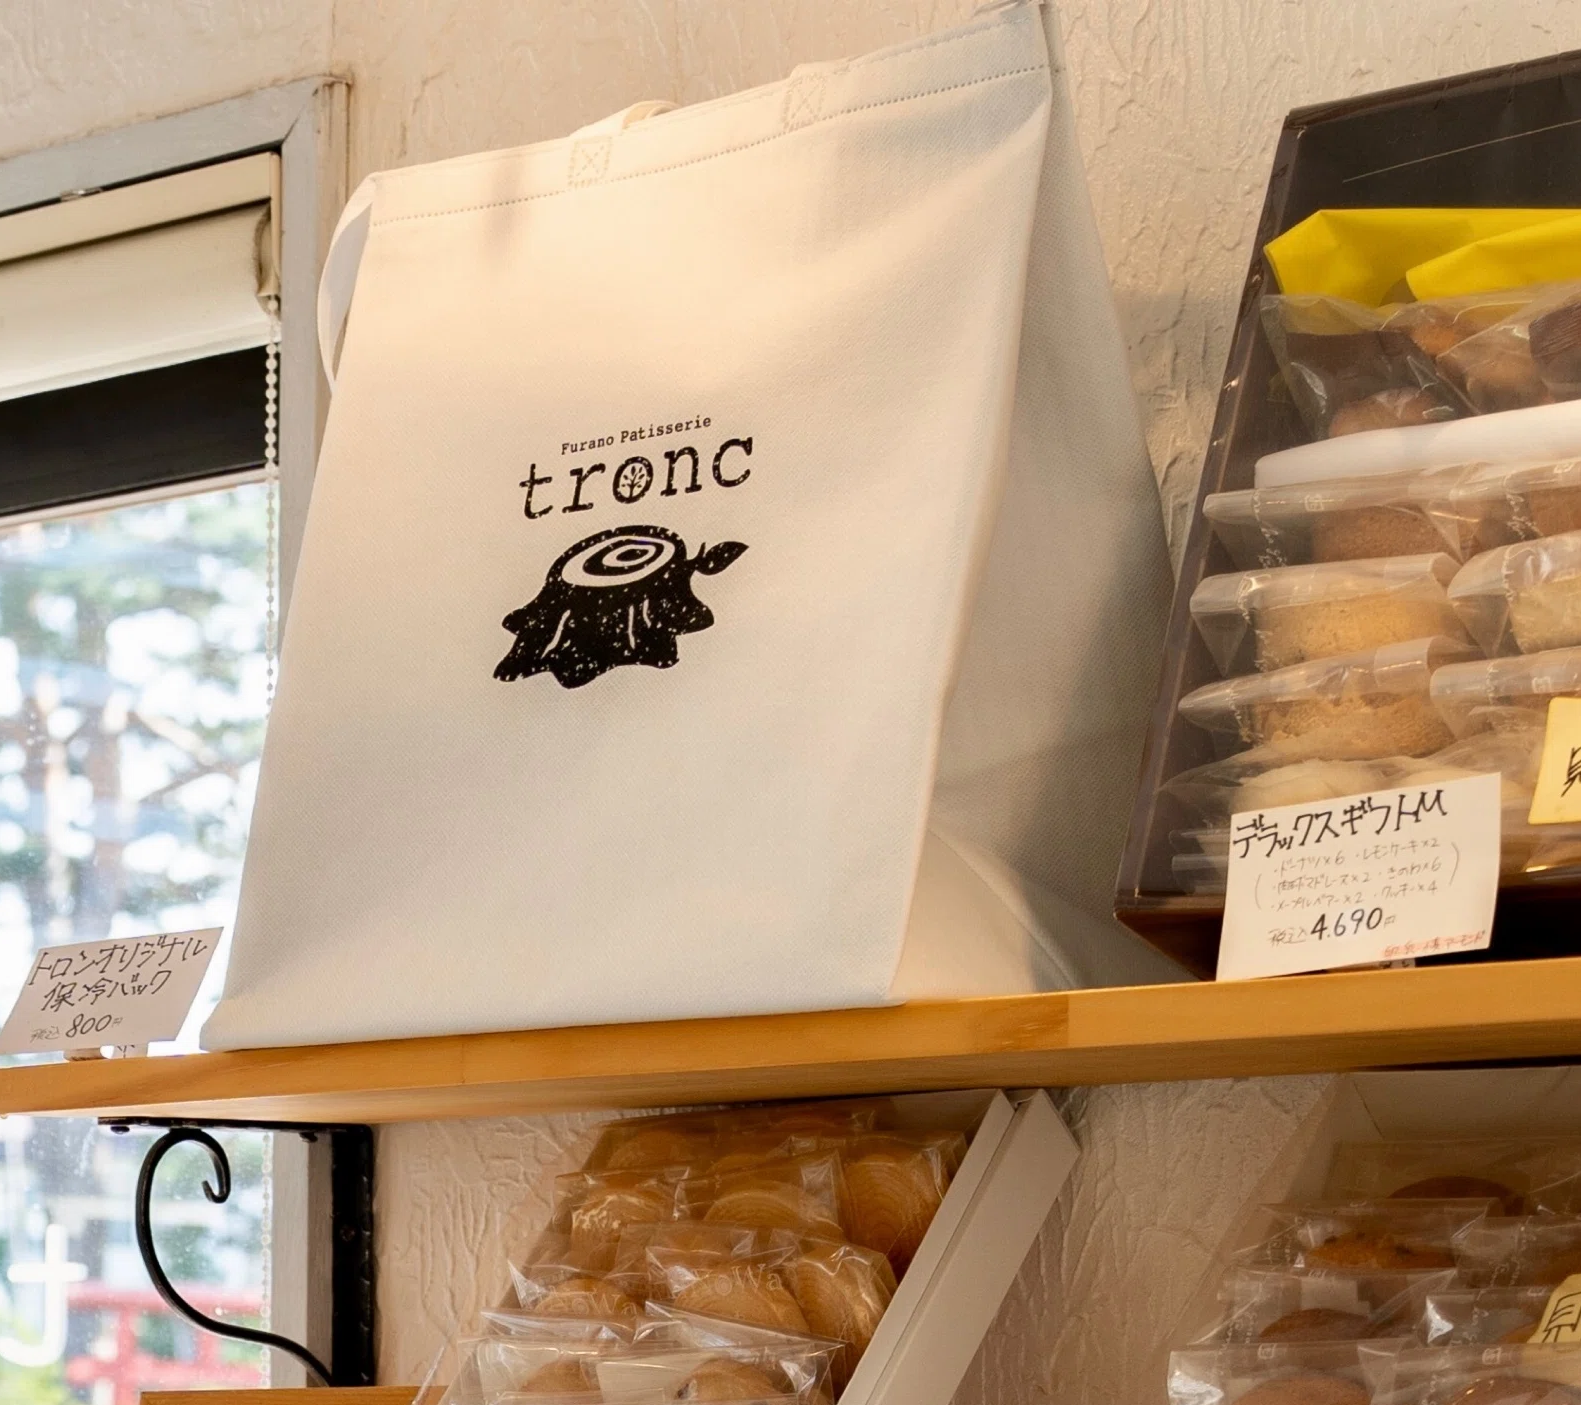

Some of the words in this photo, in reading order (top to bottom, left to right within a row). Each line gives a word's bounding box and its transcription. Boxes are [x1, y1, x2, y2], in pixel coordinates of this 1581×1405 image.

[561, 434, 614, 456] Furano
[620, 415, 712, 444] Patisserie
[519, 436, 753, 520] tronc
[1233, 789, 1448, 858] デラックスギフトM
[28, 935, 207, 985] トロンオリジナル
